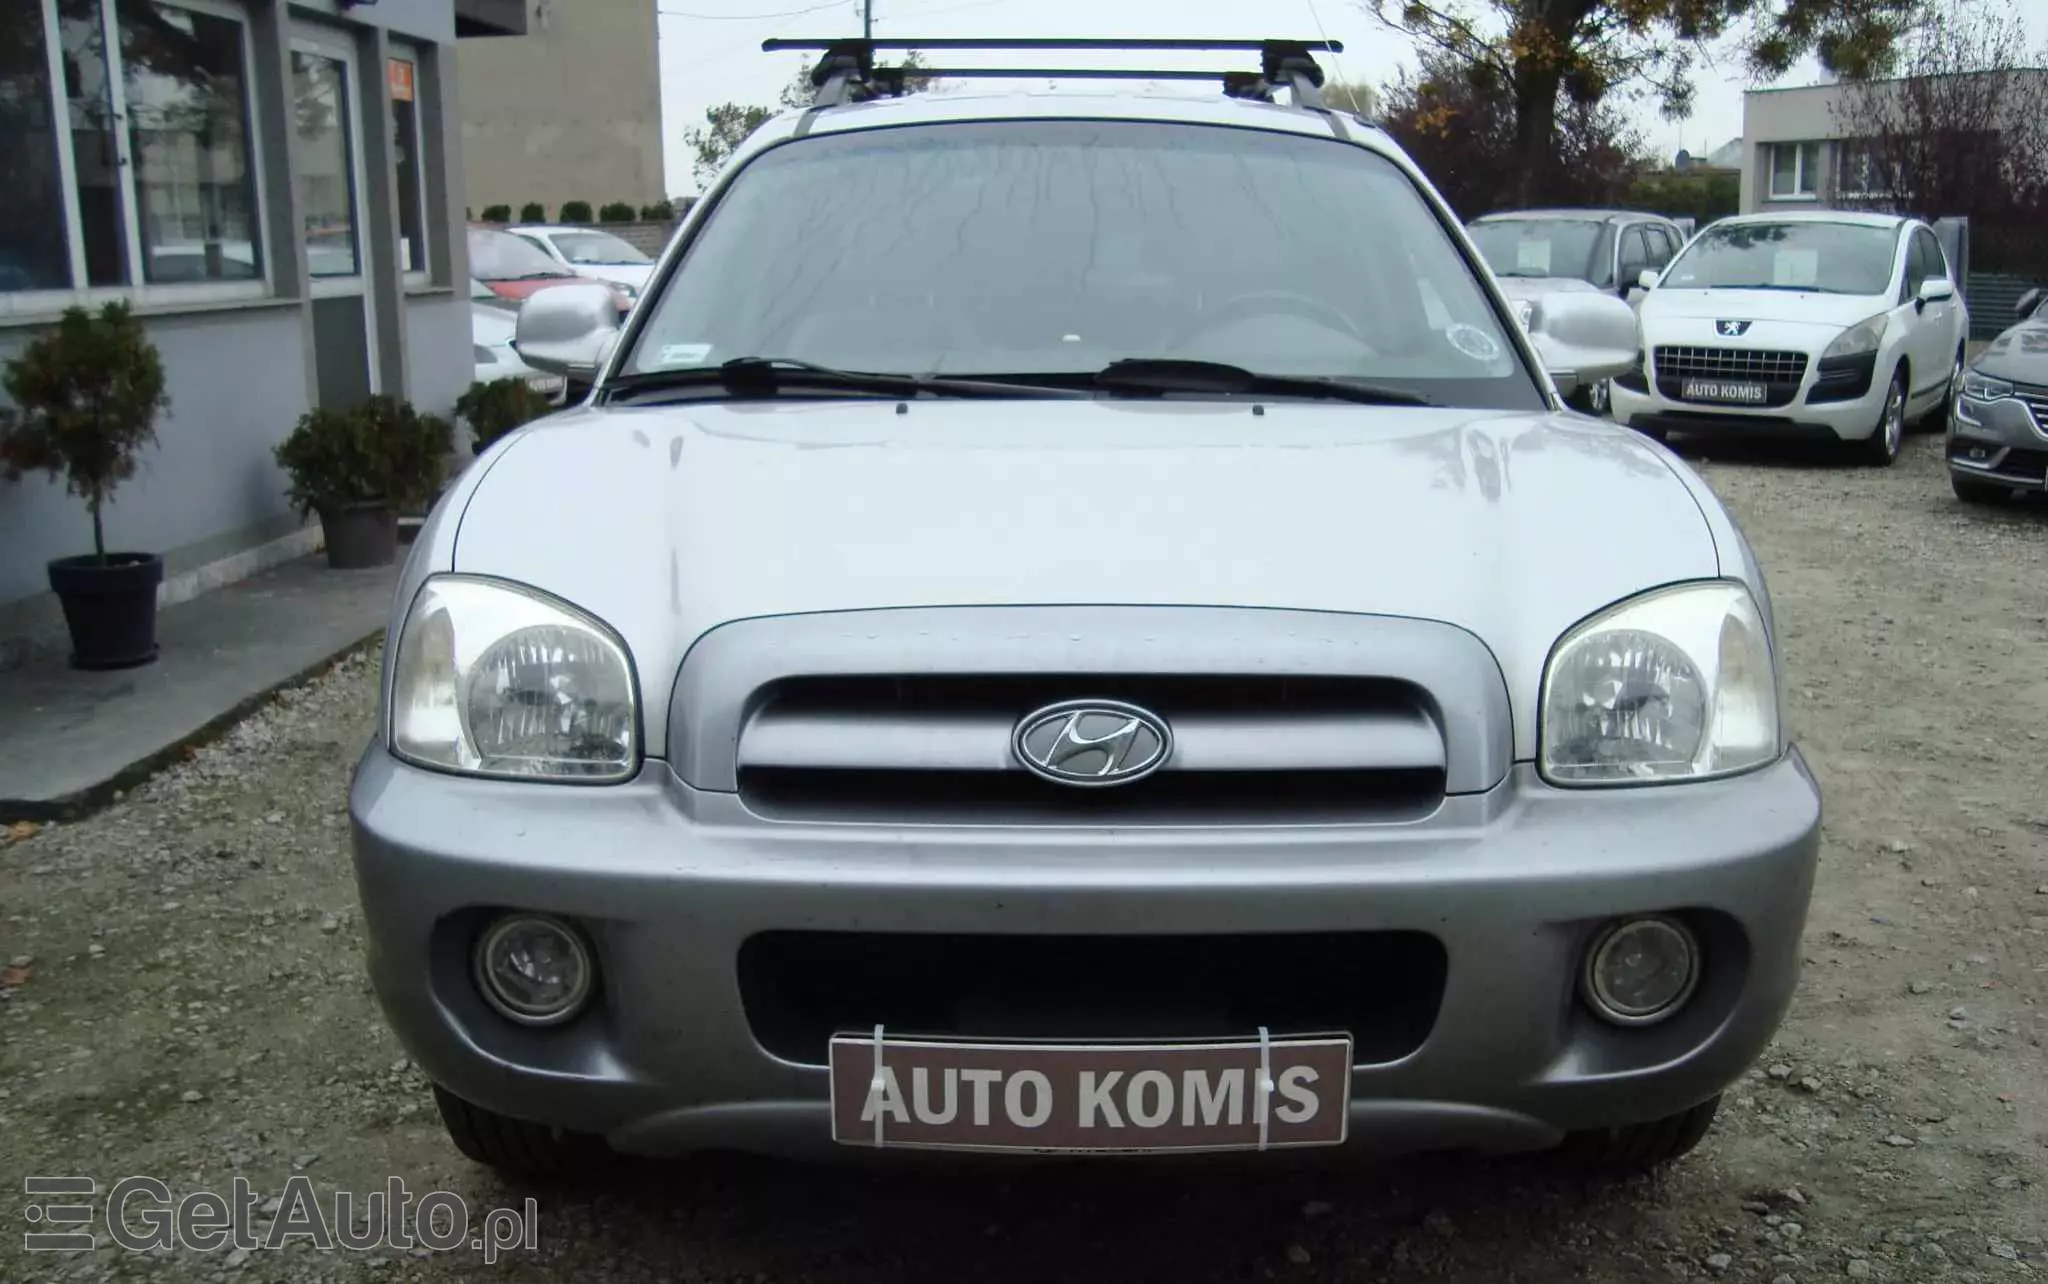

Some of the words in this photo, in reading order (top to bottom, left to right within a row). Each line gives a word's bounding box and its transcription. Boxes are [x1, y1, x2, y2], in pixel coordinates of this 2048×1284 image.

[1686, 383, 1718, 397] AUTO
[1721, 384, 1762, 399] KOMIS
[861, 1066, 1052, 1127] AUTO
[1079, 1065, 1320, 1128] KOMIS
